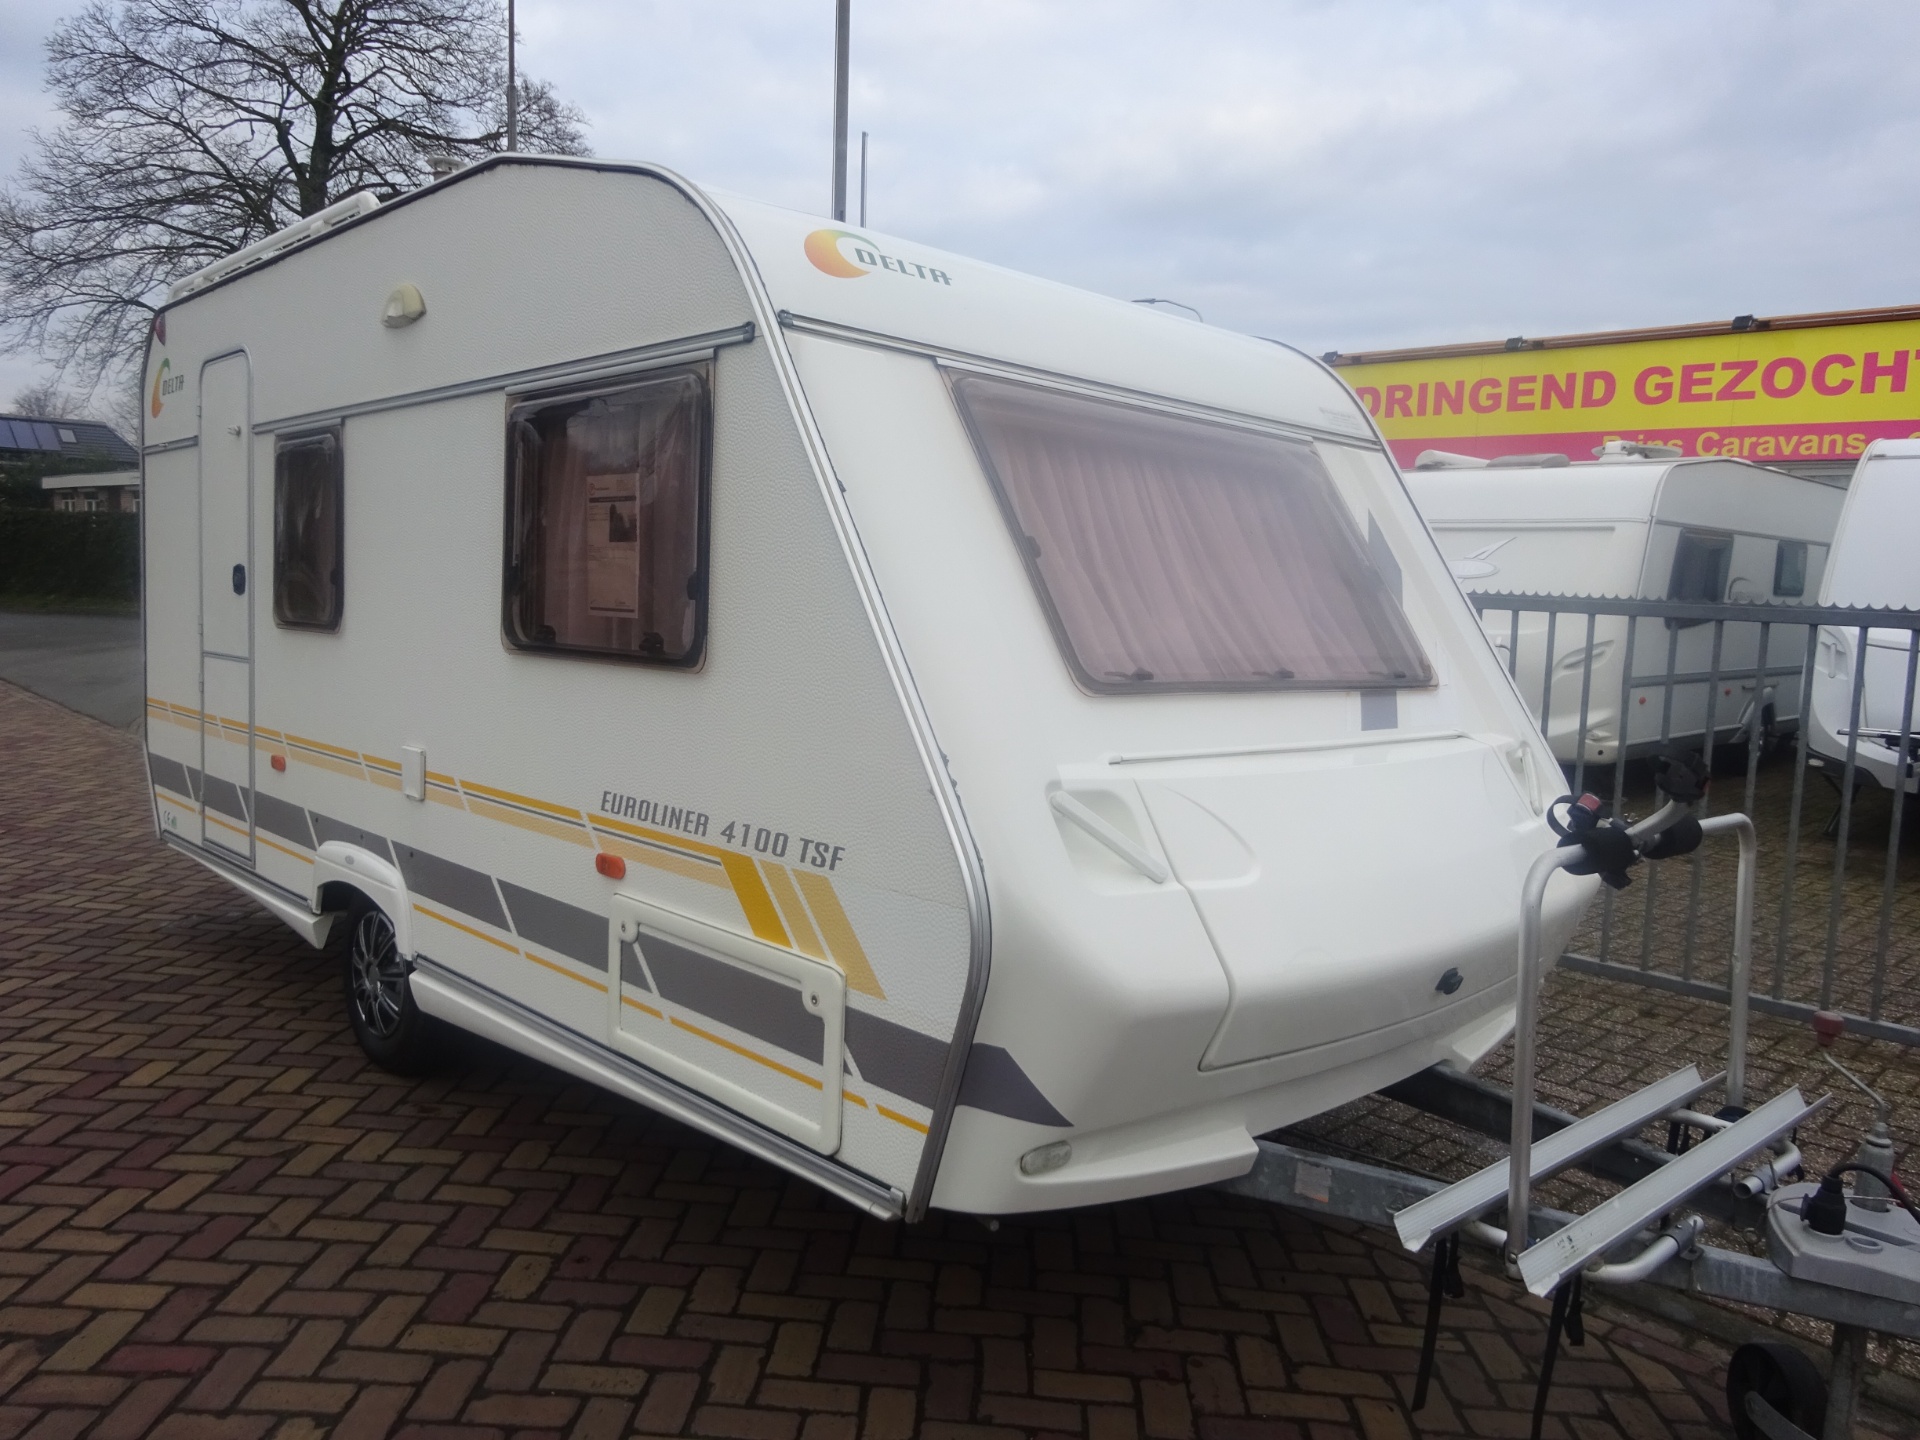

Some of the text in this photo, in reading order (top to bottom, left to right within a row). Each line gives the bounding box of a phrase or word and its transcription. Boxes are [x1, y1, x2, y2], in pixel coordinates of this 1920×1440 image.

[854, 246, 953, 287] DELTA
[162, 374, 185, 396] DELTA
[1354, 369, 1617, 420] DRINGEND
[1633, 348, 1920, 406] GEZOCH
[1696, 431, 1867, 458] Caravans
[600, 790, 846, 872] EUROLINER 4100 TSF
